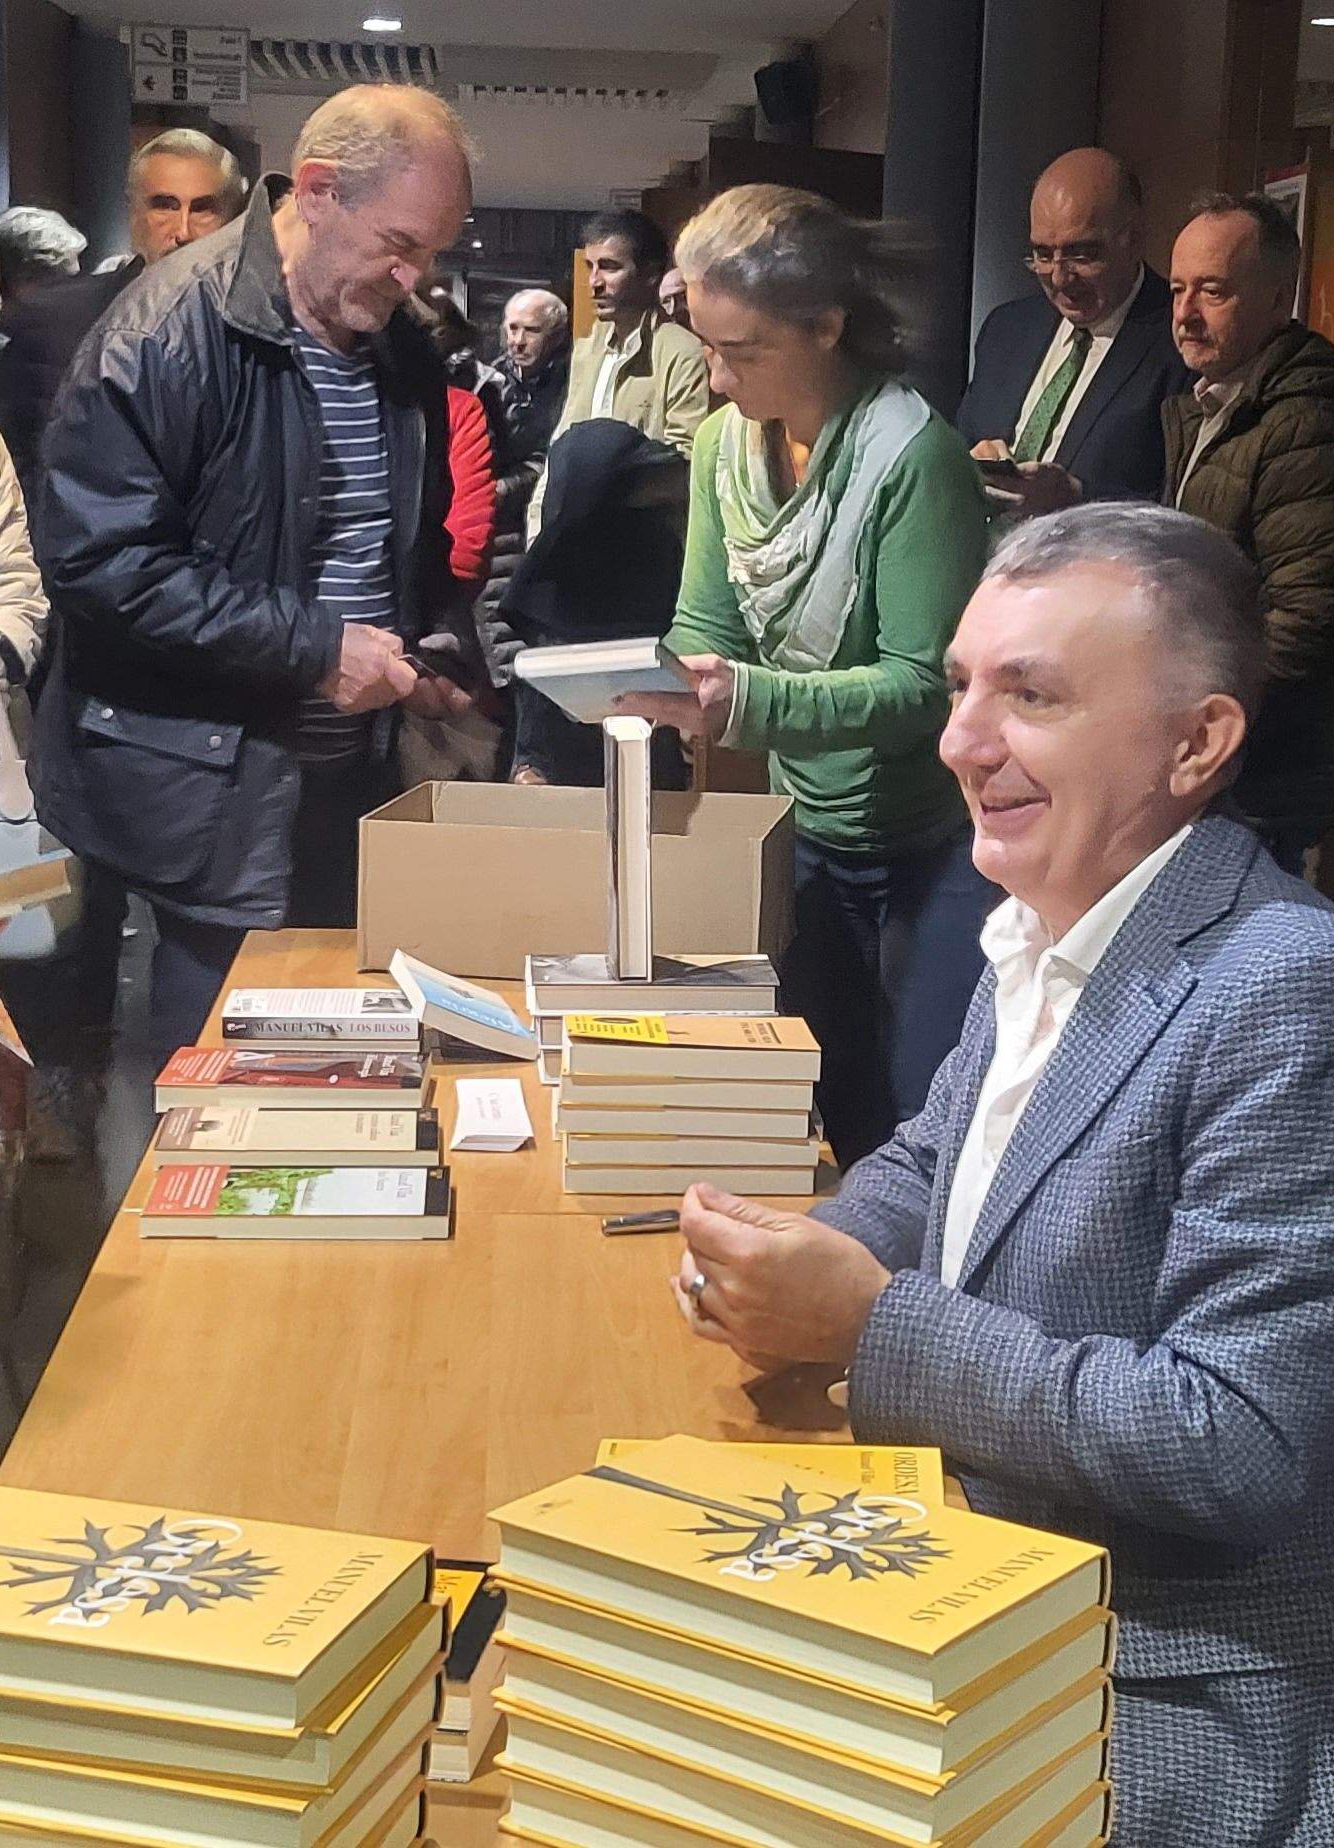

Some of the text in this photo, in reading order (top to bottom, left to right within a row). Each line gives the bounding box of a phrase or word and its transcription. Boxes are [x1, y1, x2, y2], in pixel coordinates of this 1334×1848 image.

[255, 1022, 411, 1034] MANUEL VILAS LOS BESOS
[304, 1551, 384, 1604] MANUEL
[908, 1546, 1055, 1625] MANUEL VILAS
[262, 1608, 325, 1648] VILAS
